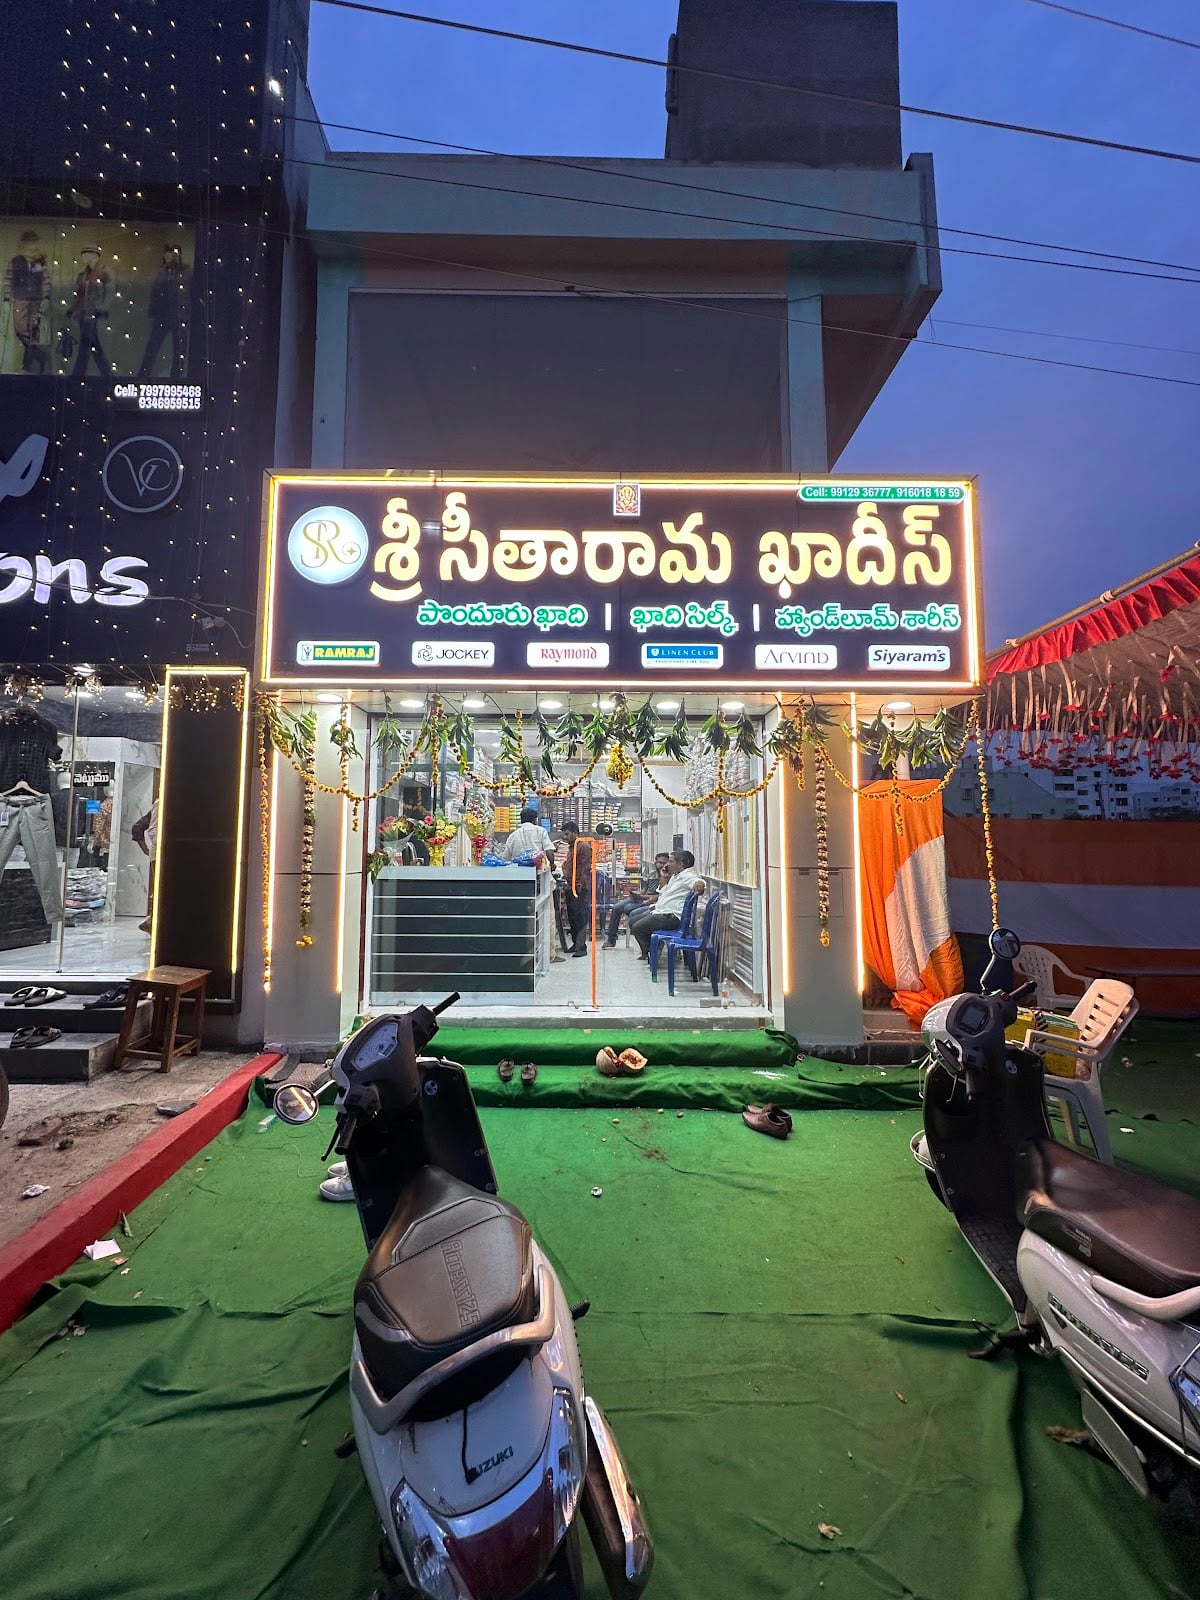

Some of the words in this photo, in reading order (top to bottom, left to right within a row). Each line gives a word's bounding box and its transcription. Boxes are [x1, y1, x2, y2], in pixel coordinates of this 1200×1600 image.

[114, 384, 137, 397] Cell:
[139, 384, 202, 397] 7997995468
[805, 486, 828, 497] Cell:
[830, 486, 860, 497] 99129
[862, 486, 895, 498] 36777,
[896, 486, 932, 498] 916018
[934, 487, 946, 498] 18
[948, 487, 961, 498] 59
[439, 491, 732, 584] సీతారామ
[758, 501, 952, 600] ఖాదీస్
[0, 552, 149, 606] ons
[630, 605, 685, 632] ఖాది
[314, 647, 375, 659] RAMRAJ
[435, 649, 489, 660] JOCKEY
[540, 646, 598, 663] Raymond
[467, 1445, 514, 1485] UZUKI
